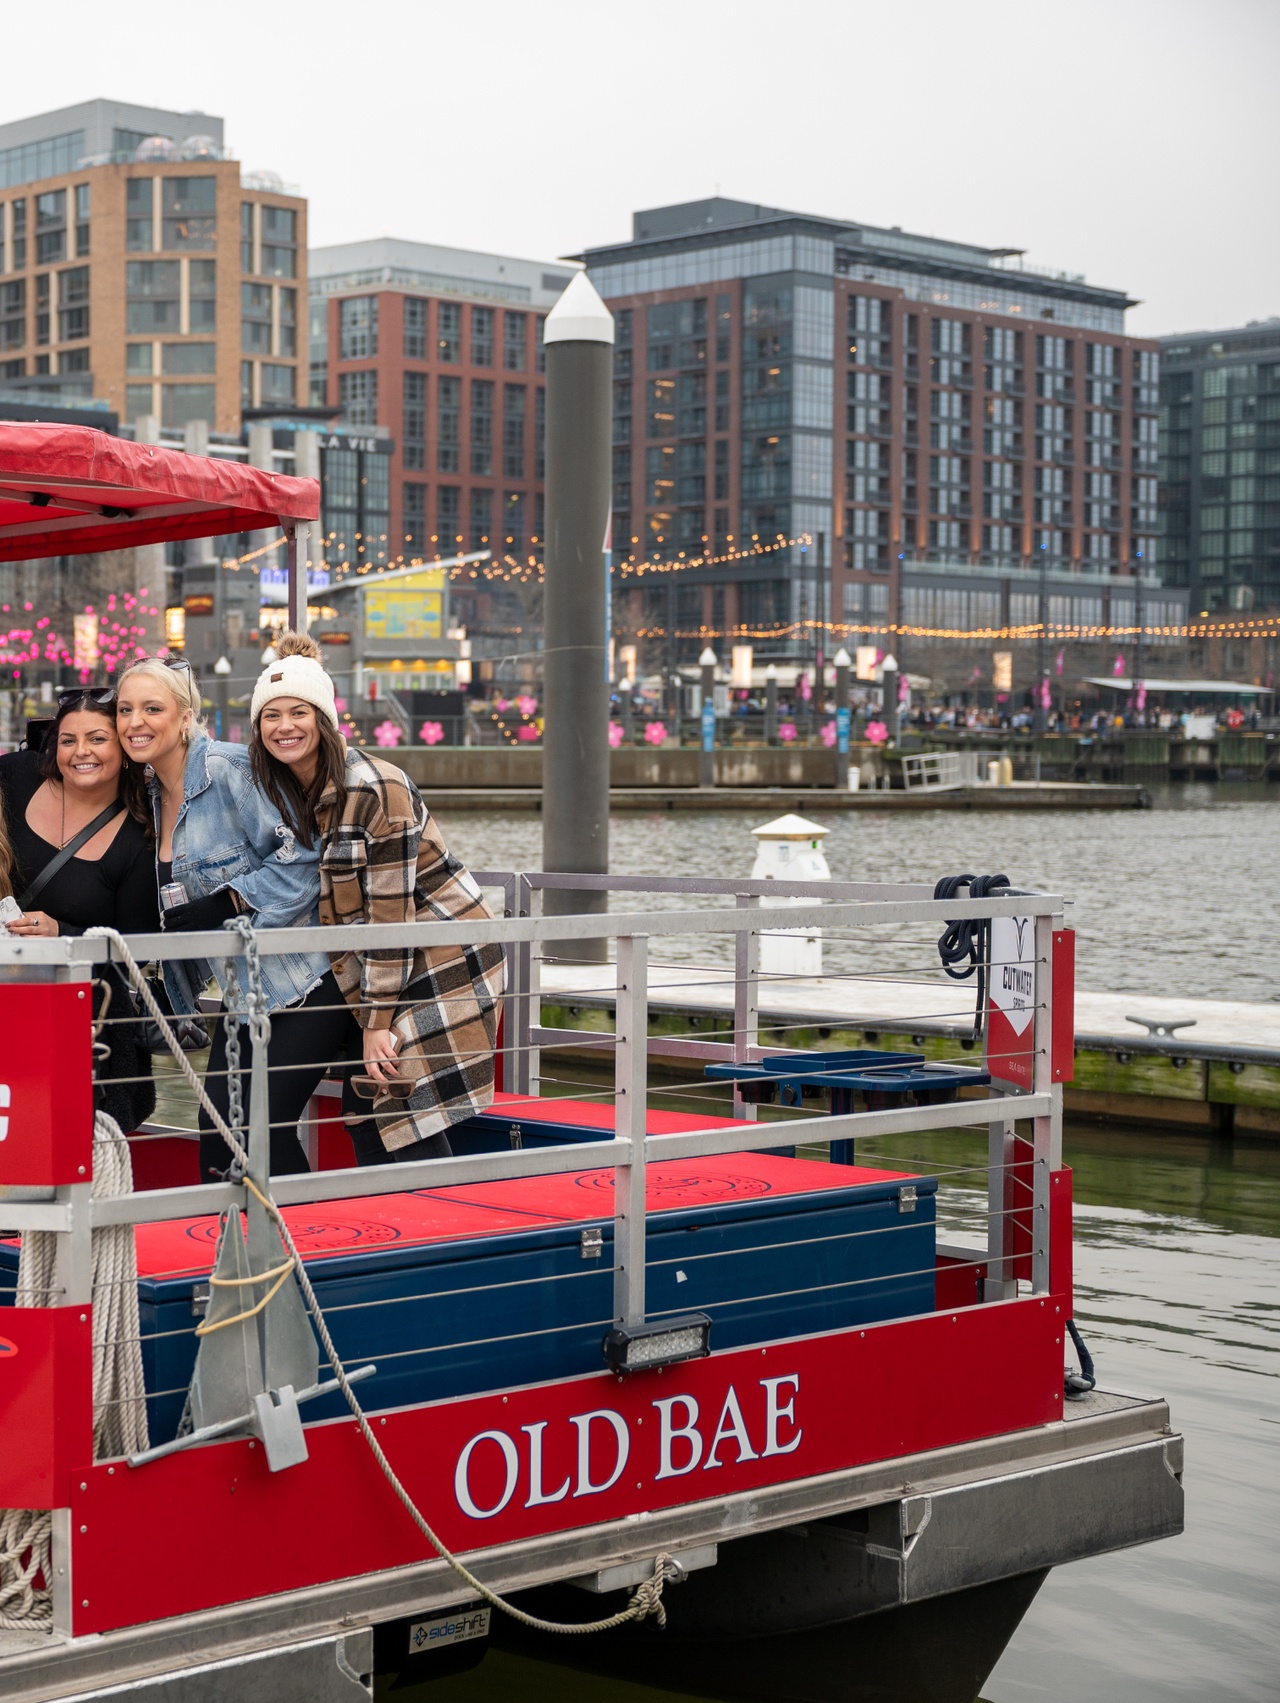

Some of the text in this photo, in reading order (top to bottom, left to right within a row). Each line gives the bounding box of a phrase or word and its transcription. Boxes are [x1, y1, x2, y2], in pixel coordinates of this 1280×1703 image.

[347, 436, 378, 453] VIE
[1002, 965, 1032, 997] CUTWATER
[454, 1373, 803, 1520] OLD BAE
[429, 1613, 486, 1640] sideshift
